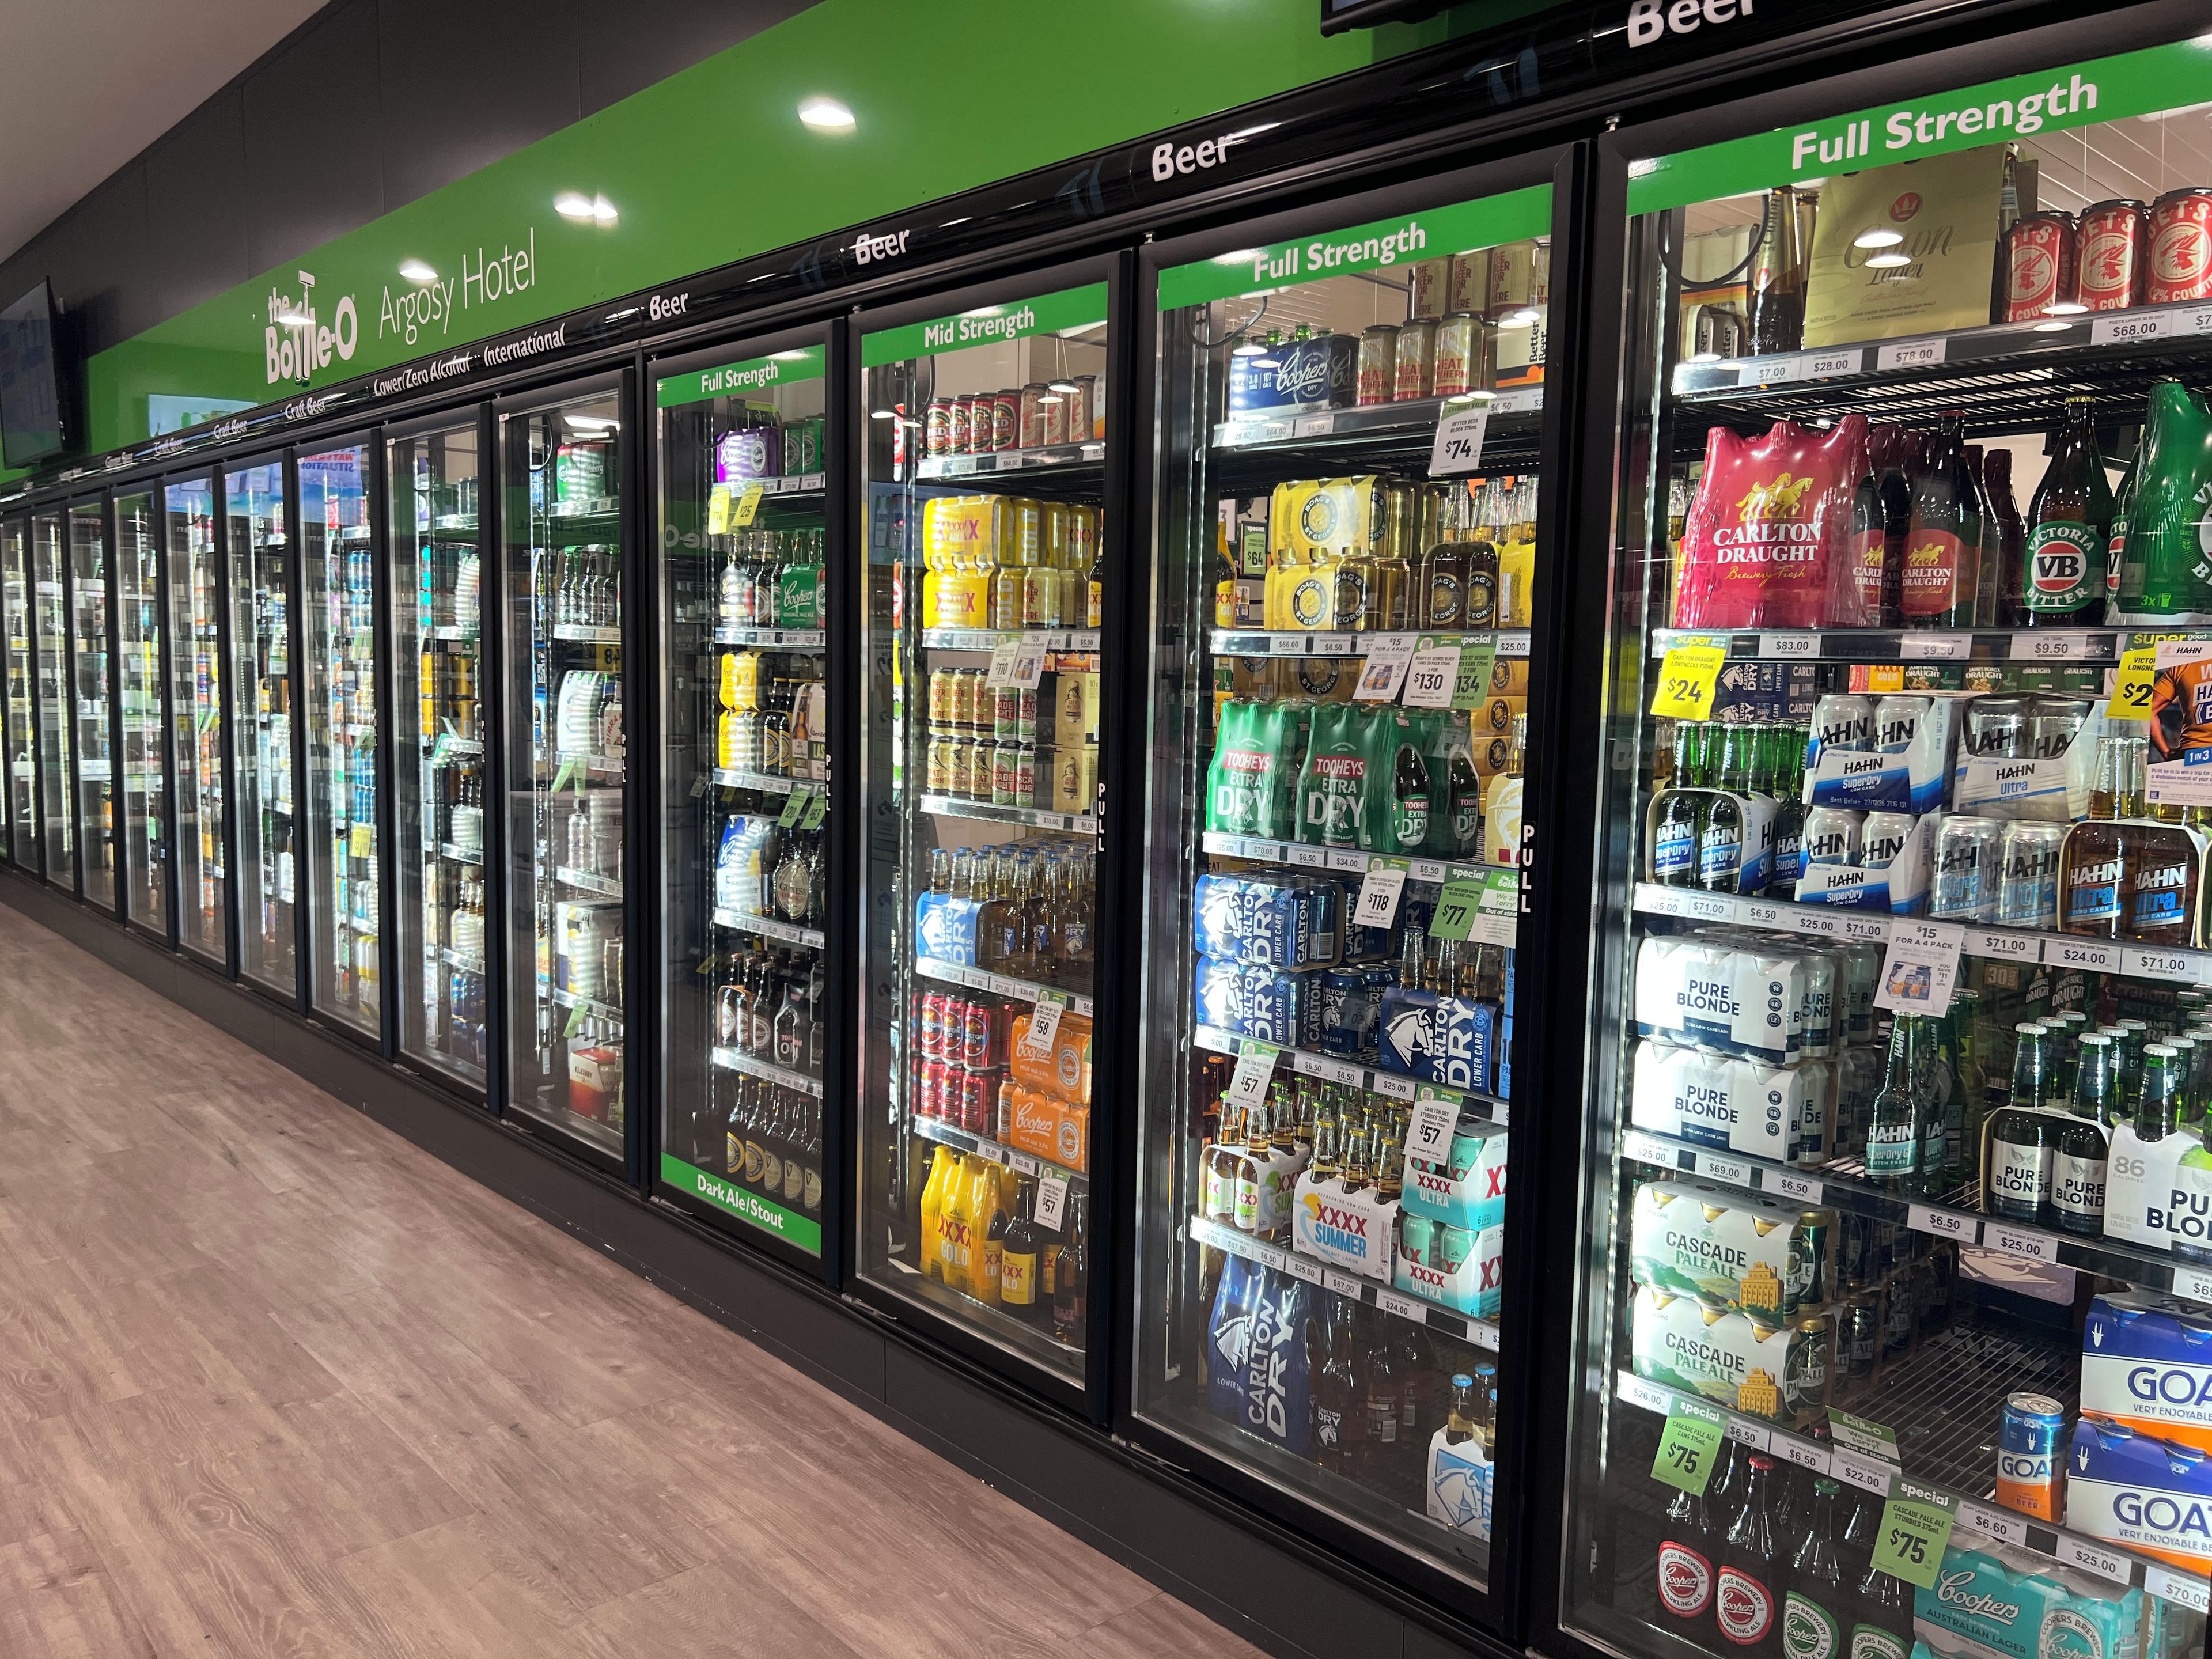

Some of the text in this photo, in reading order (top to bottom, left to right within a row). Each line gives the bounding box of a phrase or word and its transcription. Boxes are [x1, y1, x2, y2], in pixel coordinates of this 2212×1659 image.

[1627, 0, 1756, 48] Beer
[1791, 74, 2097, 170] Full Strength
[1153, 132, 1233, 183] Beer
[855, 229, 910, 266] Beer
[1254, 222, 1426, 282] Full Strength
[379, 227, 535, 346] Argosy Hotel
[268, 287, 290, 323] the
[650, 292, 688, 321] Beer
[925, 305, 1035, 349] Mid Strength
[2112, 322, 2157, 337] $68.00
[484, 323, 566, 367] International
[430, 351, 471, 382] Alcohol
[1814, 359, 1849, 373] $28.00
[1895, 349, 1933, 363] $78.00
[701, 361, 779, 393] Full Strength
[1277, 349, 1328, 391] Coopers
[1759, 367, 1786, 379] $7.00
[285, 396, 326, 421] Craft Beer
[1445, 438, 1472, 460] $74
[740, 505, 752, 518] $25
[1304, 497, 1330, 511] BOAG'S
[1713, 521, 1823, 547] CARLTON
[2028, 525, 2095, 553] VICTORIA
[1248, 551, 1263, 566] $64
[1717, 544, 1818, 565] DRAUGHT
[1725, 566, 1806, 588] Brewery Fresh
[1902, 567, 1952, 578] CARLTON
[2036, 555, 2080, 578] VB
[1902, 577, 1949, 587] DRAUGHT
[783, 580, 813, 608] Coopers
[2025, 586, 2089, 607] BITTER
[1278, 640, 1300, 650] $66.00
[1500, 643, 1527, 652] $25.00
[1775, 641, 1809, 651] $83.00
[1923, 645, 1954, 657] $9.50
[2034, 643, 2069, 654] $9.50
[1671, 661, 1699, 669] LONGNECKS
[1672, 654, 1694, 662] CARLTON
[1414, 672, 1444, 690] $130
[1668, 677, 1702, 703] $24
[1226, 752, 1270, 771] TOOHEYS
[1316, 759, 1364, 777] TOOHEYS
[1844, 757, 1883, 775] HAHN
[1995, 763, 2036, 781] HAHN
[1229, 773, 1263, 788] EXTRA
[1322, 778, 1357, 794] EXTRA
[1842, 774, 1883, 790] SuperDry
[1999, 780, 2029, 796] Ultra
[1216, 787, 1271, 817] DRY
[1306, 791, 1365, 829] DRY
[1830, 796, 1842, 804] Best
[1843, 797, 1861, 805] Before
[1043, 816, 1059, 825] $33.00
[1336, 857, 1358, 868] $34.00
[1521, 824, 1535, 914] PULL
[2069, 859, 2124, 886] HAHN
[1452, 868, 1485, 880] special
[1827, 872, 1864, 888] HAHN
[2135, 865, 2187, 890] HAHN
[1368, 892, 1389, 911] $118
[1826, 888, 1863, 903] SuperDry
[1442, 903, 1467, 926] $77
[1693, 902, 1724, 914] $71.00
[1750, 908, 1777, 920] $6.50
[1800, 918, 1834, 931] $25.00
[1846, 923, 1881, 937] $71.00
[1916, 926, 1937, 939] $15
[1930, 941, 1954, 949] PACK
[1986, 937, 2026, 951] $71.00
[2063, 950, 2106, 964] $24.00
[2140, 956, 2186, 971] $71.00
[1688, 979, 1729, 999] PURE
[1676, 992, 1740, 1016] BLONDE
[1036, 1019, 1050, 1035] $58
[1432, 995, 1450, 1084] CARLTON
[1448, 998, 1476, 1089] DRY
[1894, 1029, 1906, 1058] HAHN
[1241, 1075, 1259, 1093] $57
[1686, 1085, 1728, 1106] PURE
[1675, 1098, 1739, 1124] BLONDE
[1419, 1123, 1441, 1145] $57
[1868, 1123, 1913, 1143] HAHN
[1015, 1158, 1031, 1169] $23.50
[1709, 1163, 1740, 1179] $69.00
[2005, 1165, 2043, 1181] PURE
[2113, 1155, 2145, 1176] 86
[1417, 1173, 1453, 1196] XXXX
[1781, 1179, 1808, 1194] $6.50
[1995, 1176, 2051, 1194] BLONDE
[2065, 1178, 2104, 1195] PURE
[698, 1173, 783, 1229] Dark Ale/Stout
[1041, 1197, 1056, 1214] $57
[1418, 1191, 1449, 1209] ULTRA
[1316, 1202, 1368, 1237] XXXX
[1929, 1213, 1960, 1230] $6.50
[938, 1213, 972, 1249] XXXX
[1314, 1224, 1368, 1260] SUMMER
[1666, 1230, 1747, 1267] CASCADE
[2000, 1237, 2041, 1255] $25.00
[941, 1240, 968, 1267] GOLD
[1675, 1249, 1736, 1280] PALE ALE
[1332, 1279, 1355, 1293] $67.00
[1384, 1300, 1408, 1316] $24.00
[1665, 1331, 1745, 1373] CASCADE
[1266, 1308, 1295, 1438] DRY
[1675, 1352, 1734, 1384] PALE ALE
[1680, 1401, 1721, 1422] special
[1729, 1426, 1755, 1443] $6.50
[1667, 1441, 1700, 1475] $75
[1844, 1442, 1858, 1451] Out
[1868, 1449, 1890, 1463] stock
[1844, 1467, 1880, 1488] $22.00
[1900, 1482, 1949, 1507] special
[1894, 1513, 1940, 1535] STUBBIES 375mL
[1975, 1516, 2008, 1535] $6.60
[1889, 1528, 1928, 1565] $75
[2118, 1528, 2198, 1550] VERY ENJOYABLE
[2075, 1550, 2116, 1573] $25.00
[1937, 1569, 2021, 1621] Coopers
[2165, 1583, 2209, 1607] $70.00
[1927, 1608, 1990, 1639] AUSTRALIAN
[1992, 1635, 2027, 1654] LAGER
